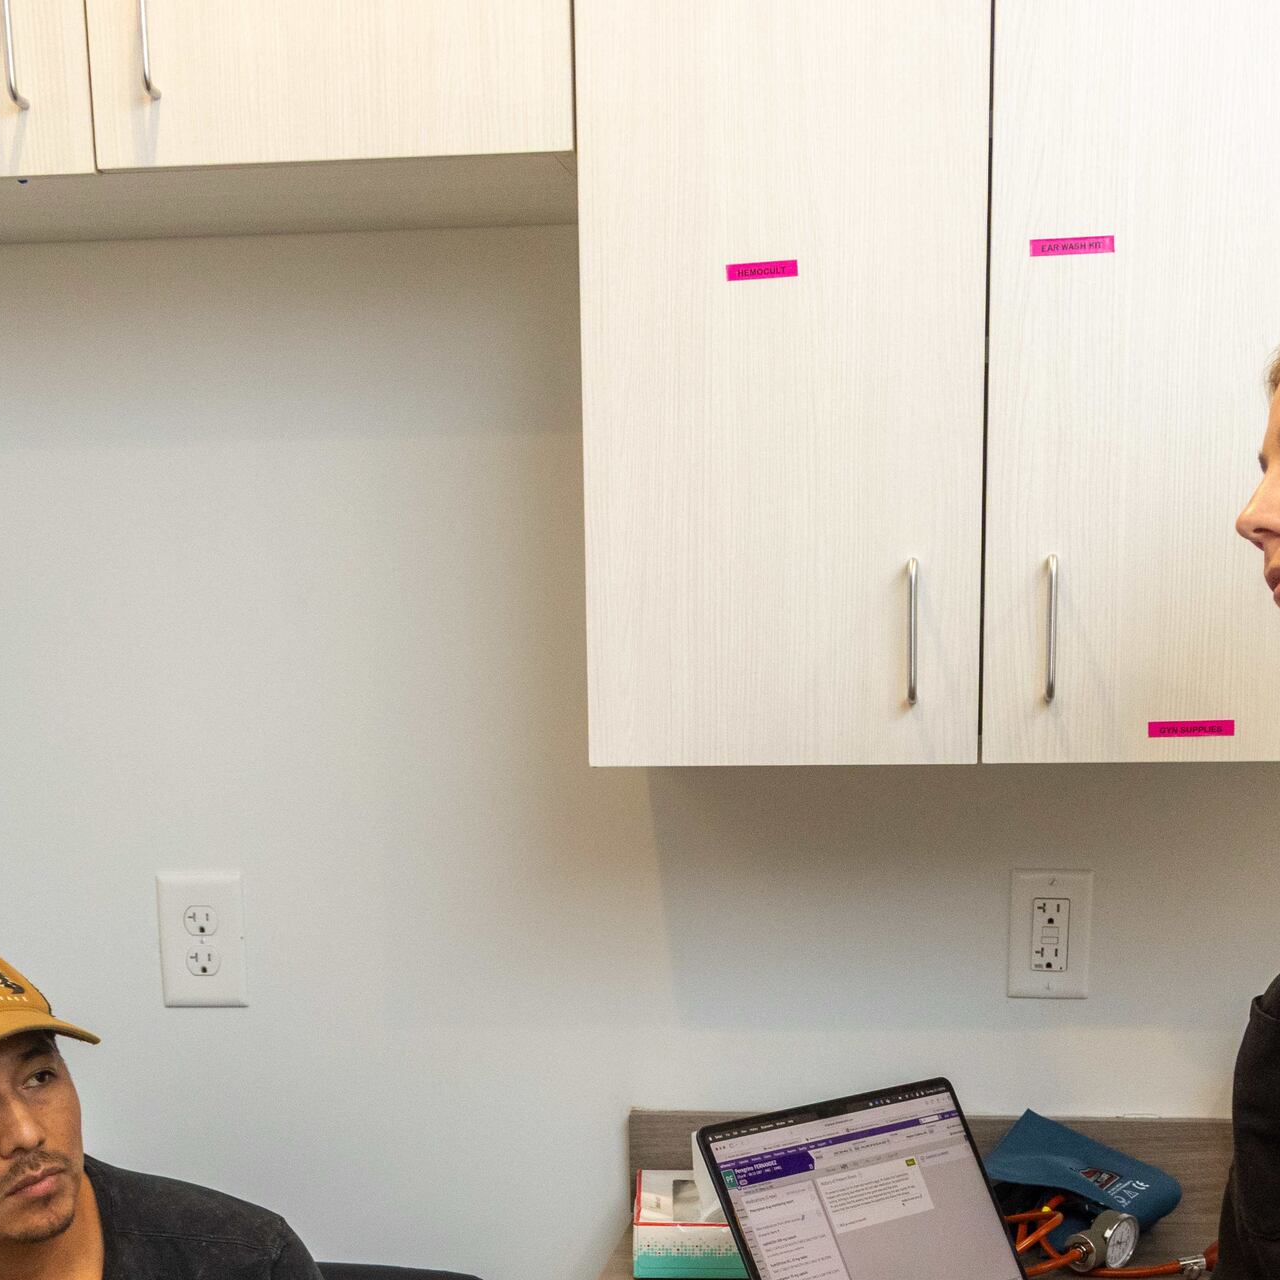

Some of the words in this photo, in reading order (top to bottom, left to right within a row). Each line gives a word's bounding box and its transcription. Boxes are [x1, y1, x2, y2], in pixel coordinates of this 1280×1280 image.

[1041, 243, 1060, 253] EAR
[1061, 242, 1087, 251] WASH
[1088, 241, 1104, 249] KIT
[736, 266, 787, 278] HEMOCULT
[1159, 726, 1179, 734] GYN
[1180, 725, 1223, 733] SUPPLIES
